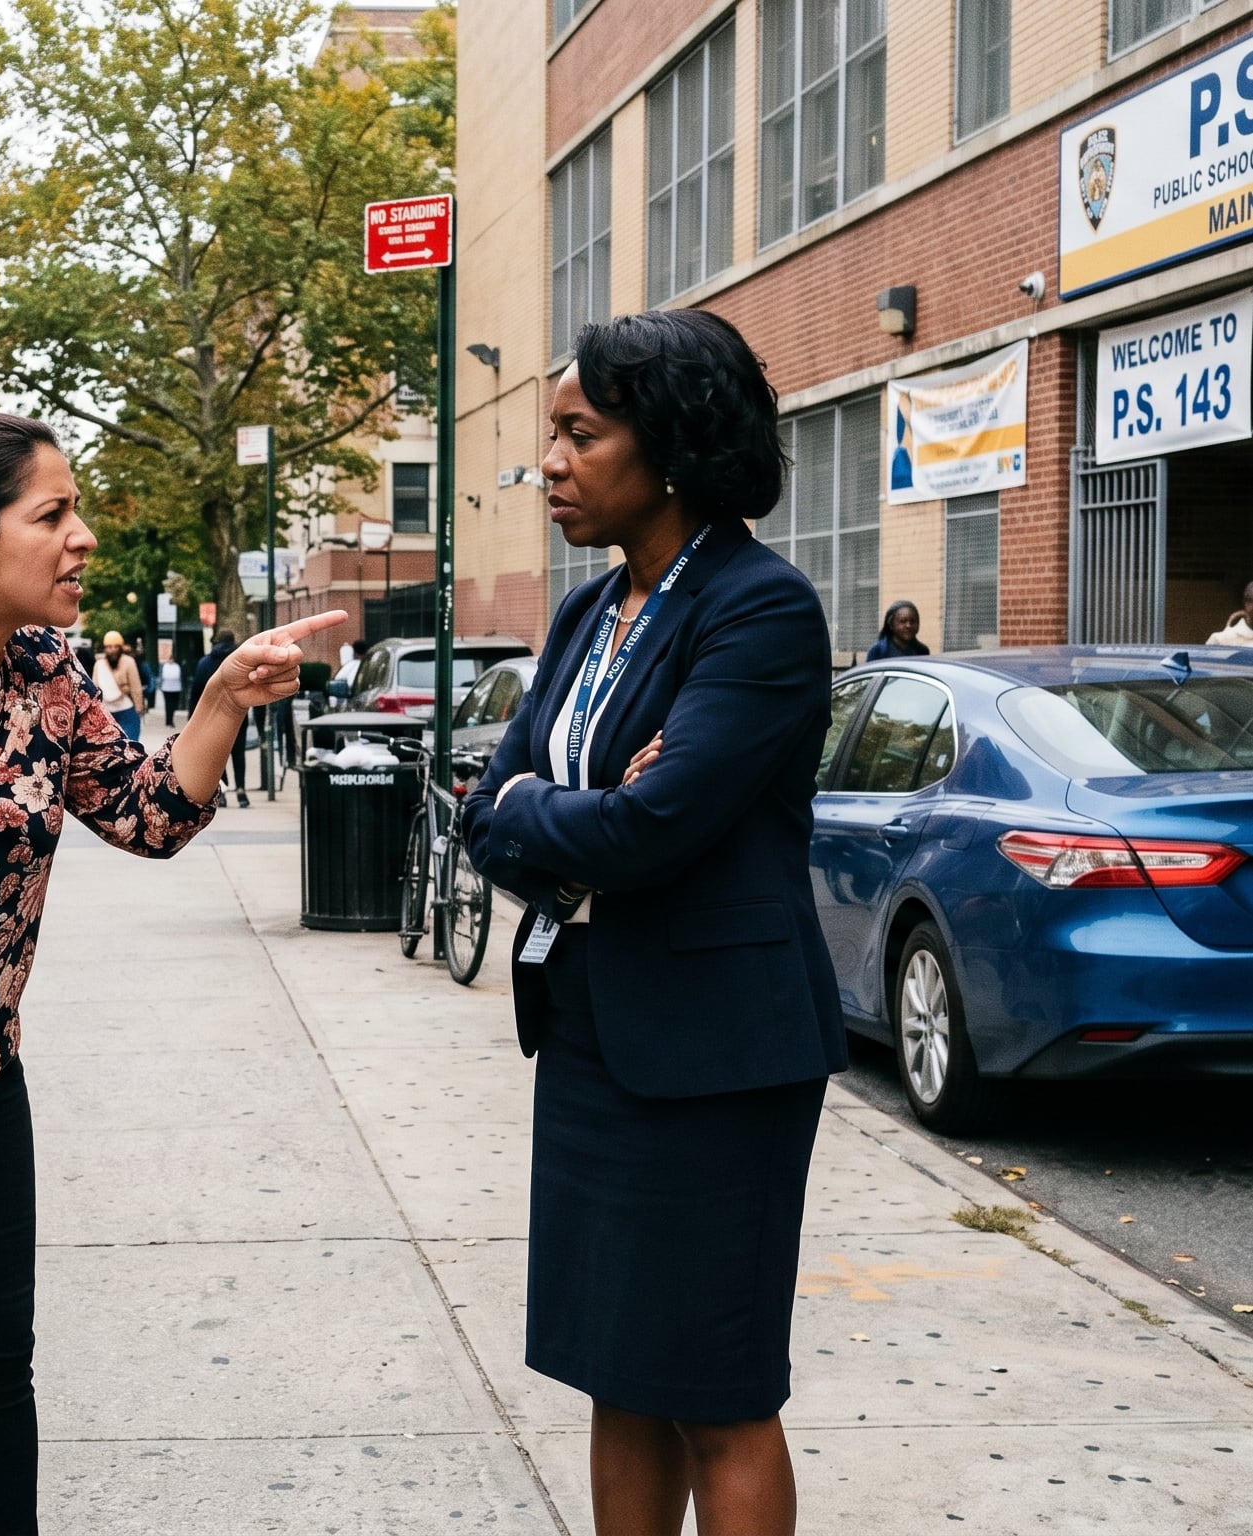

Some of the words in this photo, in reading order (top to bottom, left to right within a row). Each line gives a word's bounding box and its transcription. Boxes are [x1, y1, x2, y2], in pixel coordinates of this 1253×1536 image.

[370, 209, 386, 225] NO
[390, 202, 446, 222] STANDING
[1153, 170, 1203, 209] PUBLIC
[1112, 322, 1202, 372] WELCOME
[1210, 313, 1237, 347] TO
[1113, 383, 1162, 439] P.S.
[1175, 363, 1231, 427] 143
